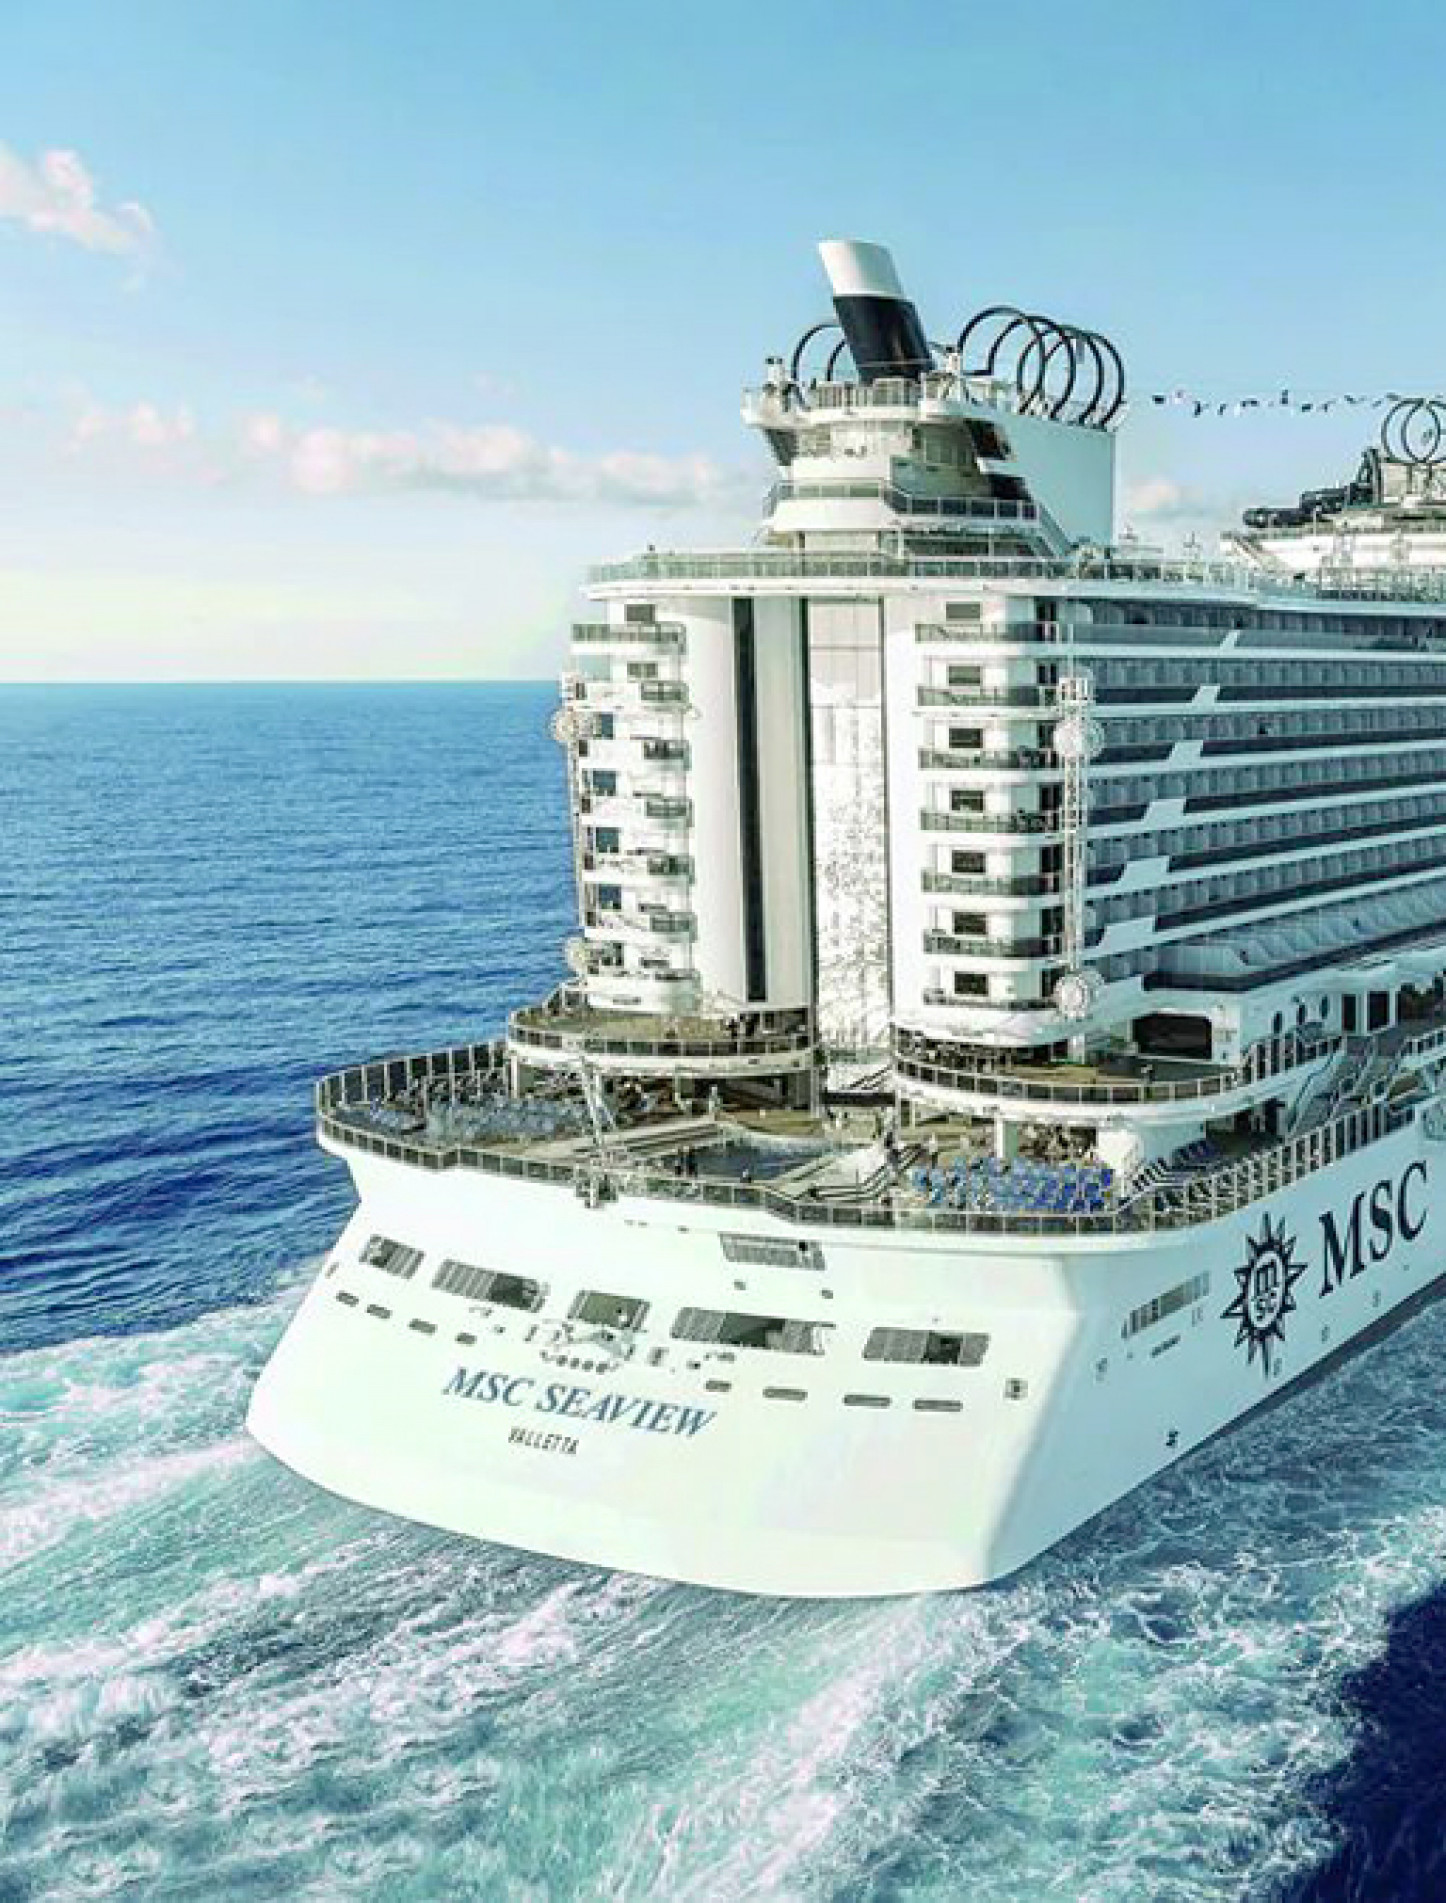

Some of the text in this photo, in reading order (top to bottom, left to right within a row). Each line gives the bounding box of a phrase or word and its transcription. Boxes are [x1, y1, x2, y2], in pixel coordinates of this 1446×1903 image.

[1318, 1159, 1428, 1299] MSC
[441, 1366, 719, 1438] MSC SEAVIEW
[507, 1427, 580, 1455] VALLETTA
